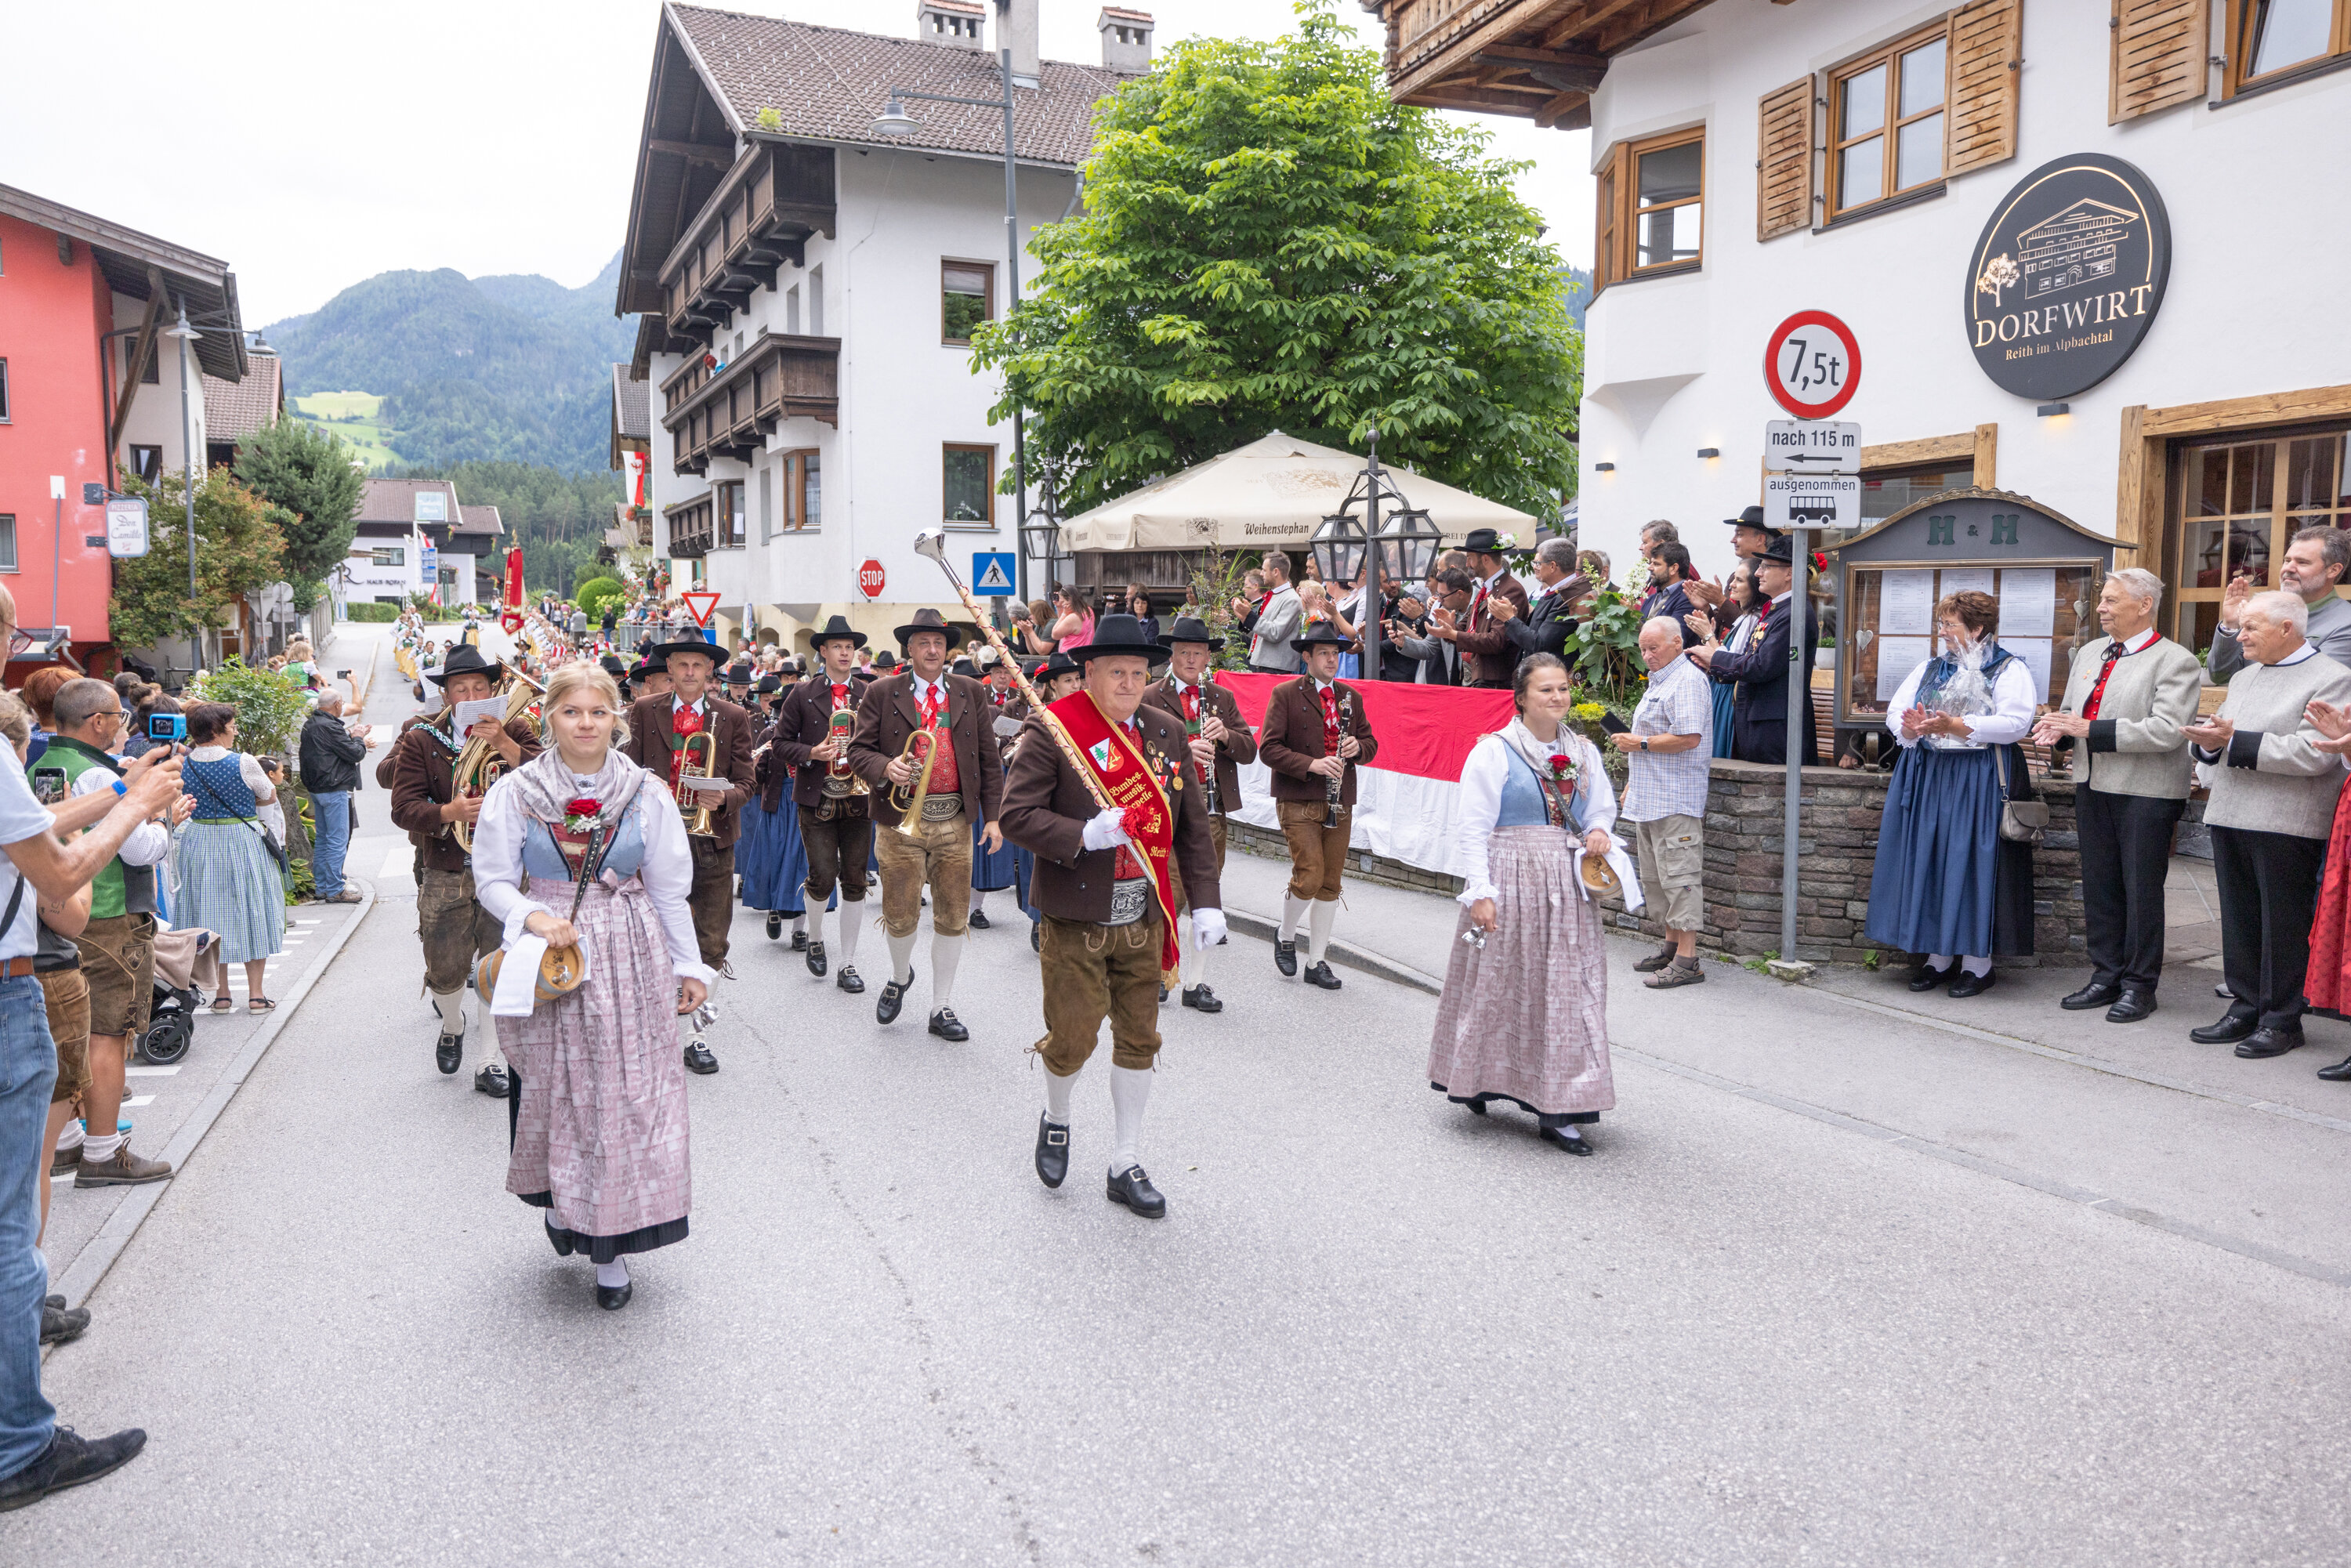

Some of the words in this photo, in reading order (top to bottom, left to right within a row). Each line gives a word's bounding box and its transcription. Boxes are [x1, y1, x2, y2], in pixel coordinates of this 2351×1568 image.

[1974, 283, 2152, 348] DORFWIRT
[2005, 345, 2033, 360] Reith
[2036, 342, 2050, 355] im
[2052, 329, 2113, 352] Alpbachtal
[1772, 430, 1806, 446] nach
[1811, 429, 1837, 447] 115
[1842, 433, 1855, 447] m
[1770, 479, 1856, 492] ausgenommen
[116, 514, 136, 527] Don
[1244, 522, 1309, 536] Weihenstephan
[1927, 515, 1956, 545] H
[1967, 524, 1979, 536] &
[1990, 514, 2020, 545] H
[110, 527, 143, 539] Camillo
[861, 570, 883, 586] STOP
[1109, 772, 1143, 797] Bundes-
[1120, 782, 1147, 804] musik-
